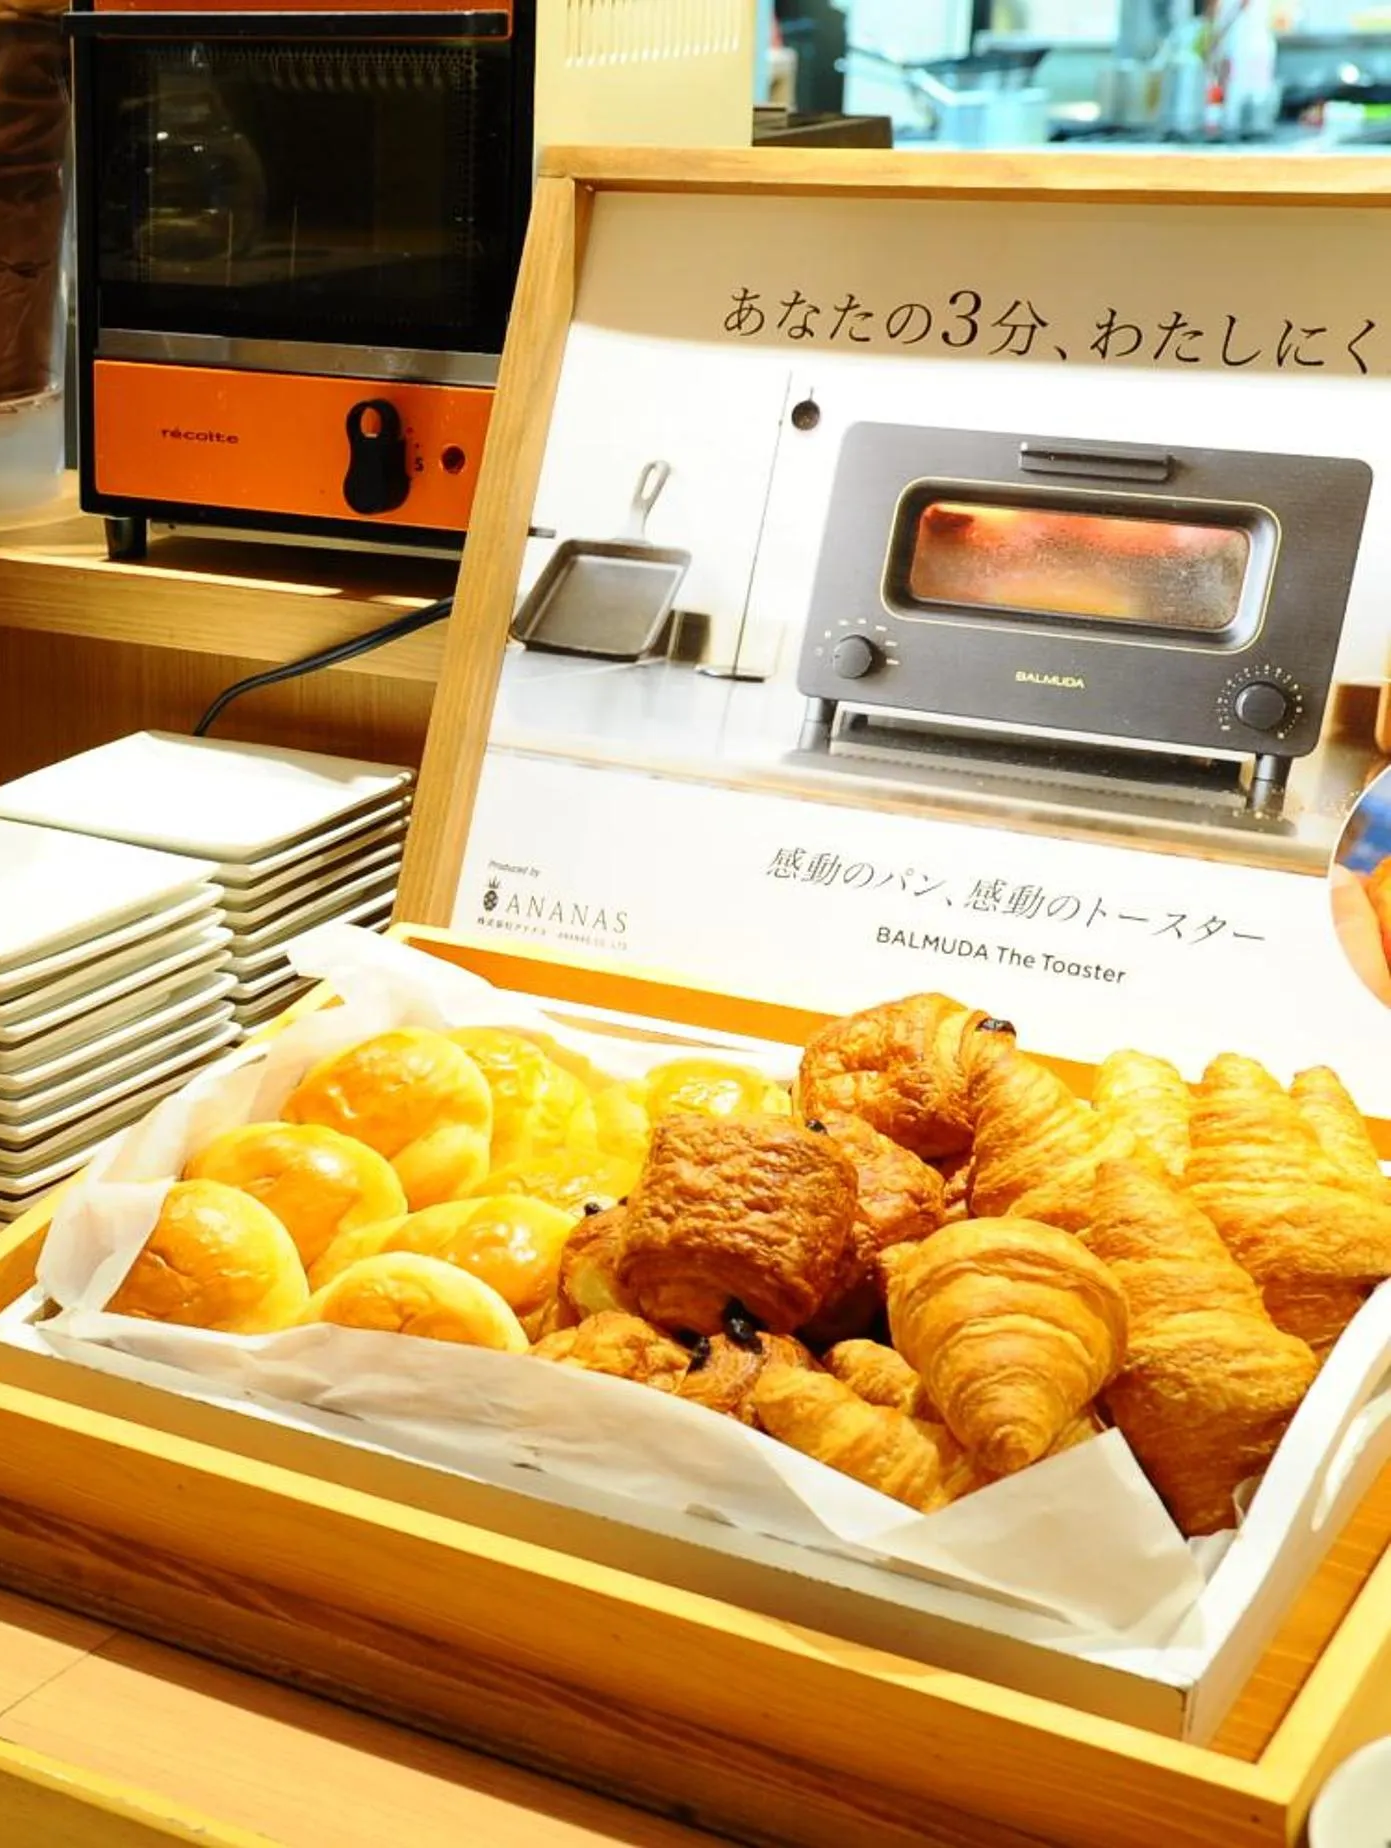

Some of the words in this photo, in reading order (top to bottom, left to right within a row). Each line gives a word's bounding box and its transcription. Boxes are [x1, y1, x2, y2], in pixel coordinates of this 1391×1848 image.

[160, 426, 240, 445] récolte
[1014, 670, 1086, 689] BALMUDA
[505, 893, 628, 934] ANANAS
[765, 846, 1267, 945] 感動のパン、感動のトースター
[875, 925, 990, 961] BALMUDA
[997, 946, 1037, 970] The
[1042, 952, 1127, 985] Toaster
